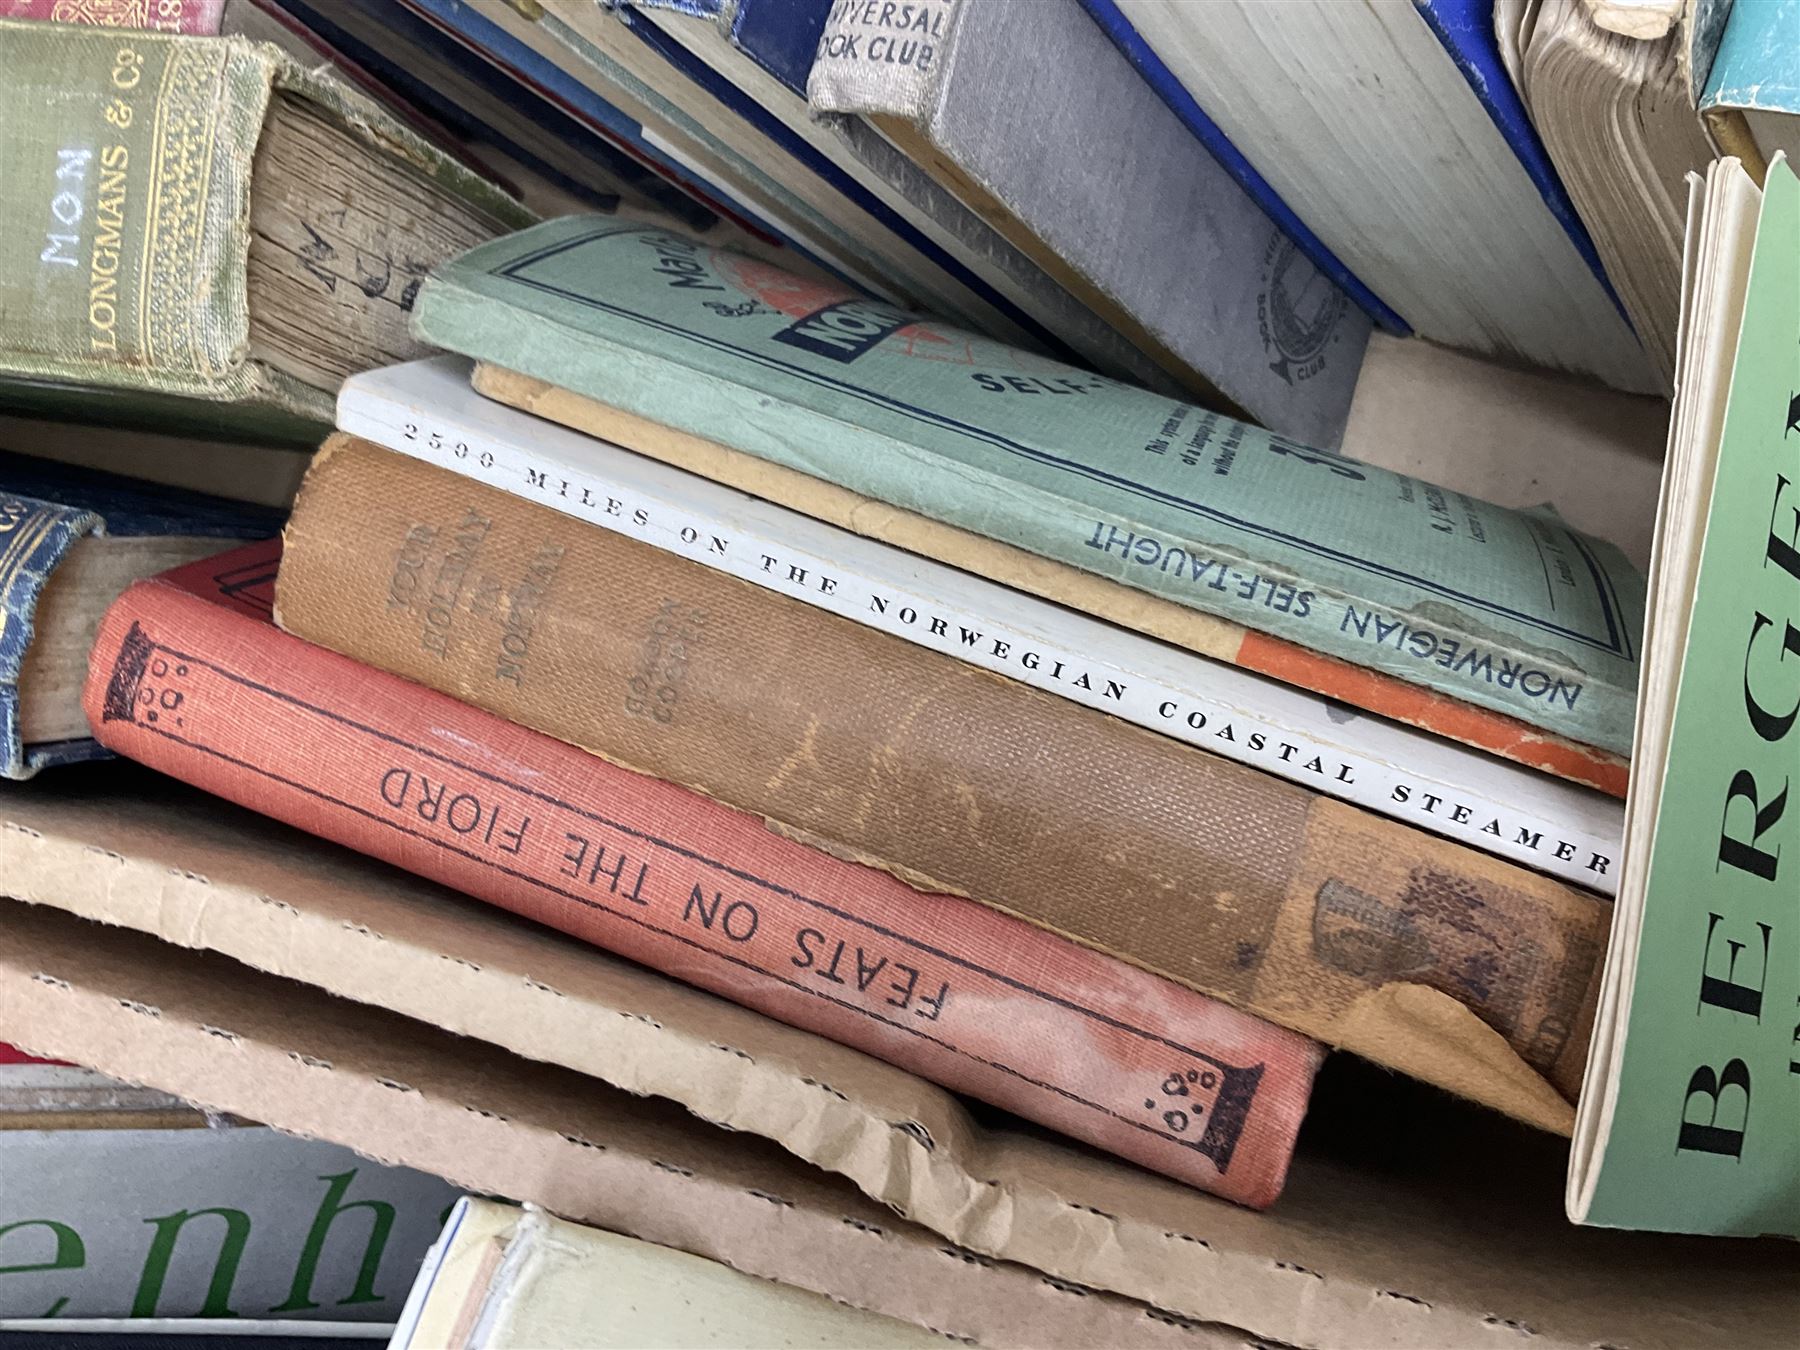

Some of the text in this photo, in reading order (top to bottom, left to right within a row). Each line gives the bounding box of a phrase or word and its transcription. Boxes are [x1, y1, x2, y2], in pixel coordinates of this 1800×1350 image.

[817, 34, 934, 72] OOK CLUB
[828, 0, 944, 38] NIVERSAL
[105, 101, 133, 129] &
[41, 149, 92, 266] MON
[90, 145, 128, 350] LONGMANS
[1297, 356, 1326, 381] CLUB
[403, 422, 1612, 877] 2500 MILES ON THE NORWEGIAN COASTAL STEAMER
[1086, 521, 1583, 711] NORWEGIAN SELF-TAUGHT
[1675, 390, 1800, 1165] BERGE
[379, 767, 951, 1022] FEATS ON THE FIORD
[0, 1168, 452, 1319] enh
